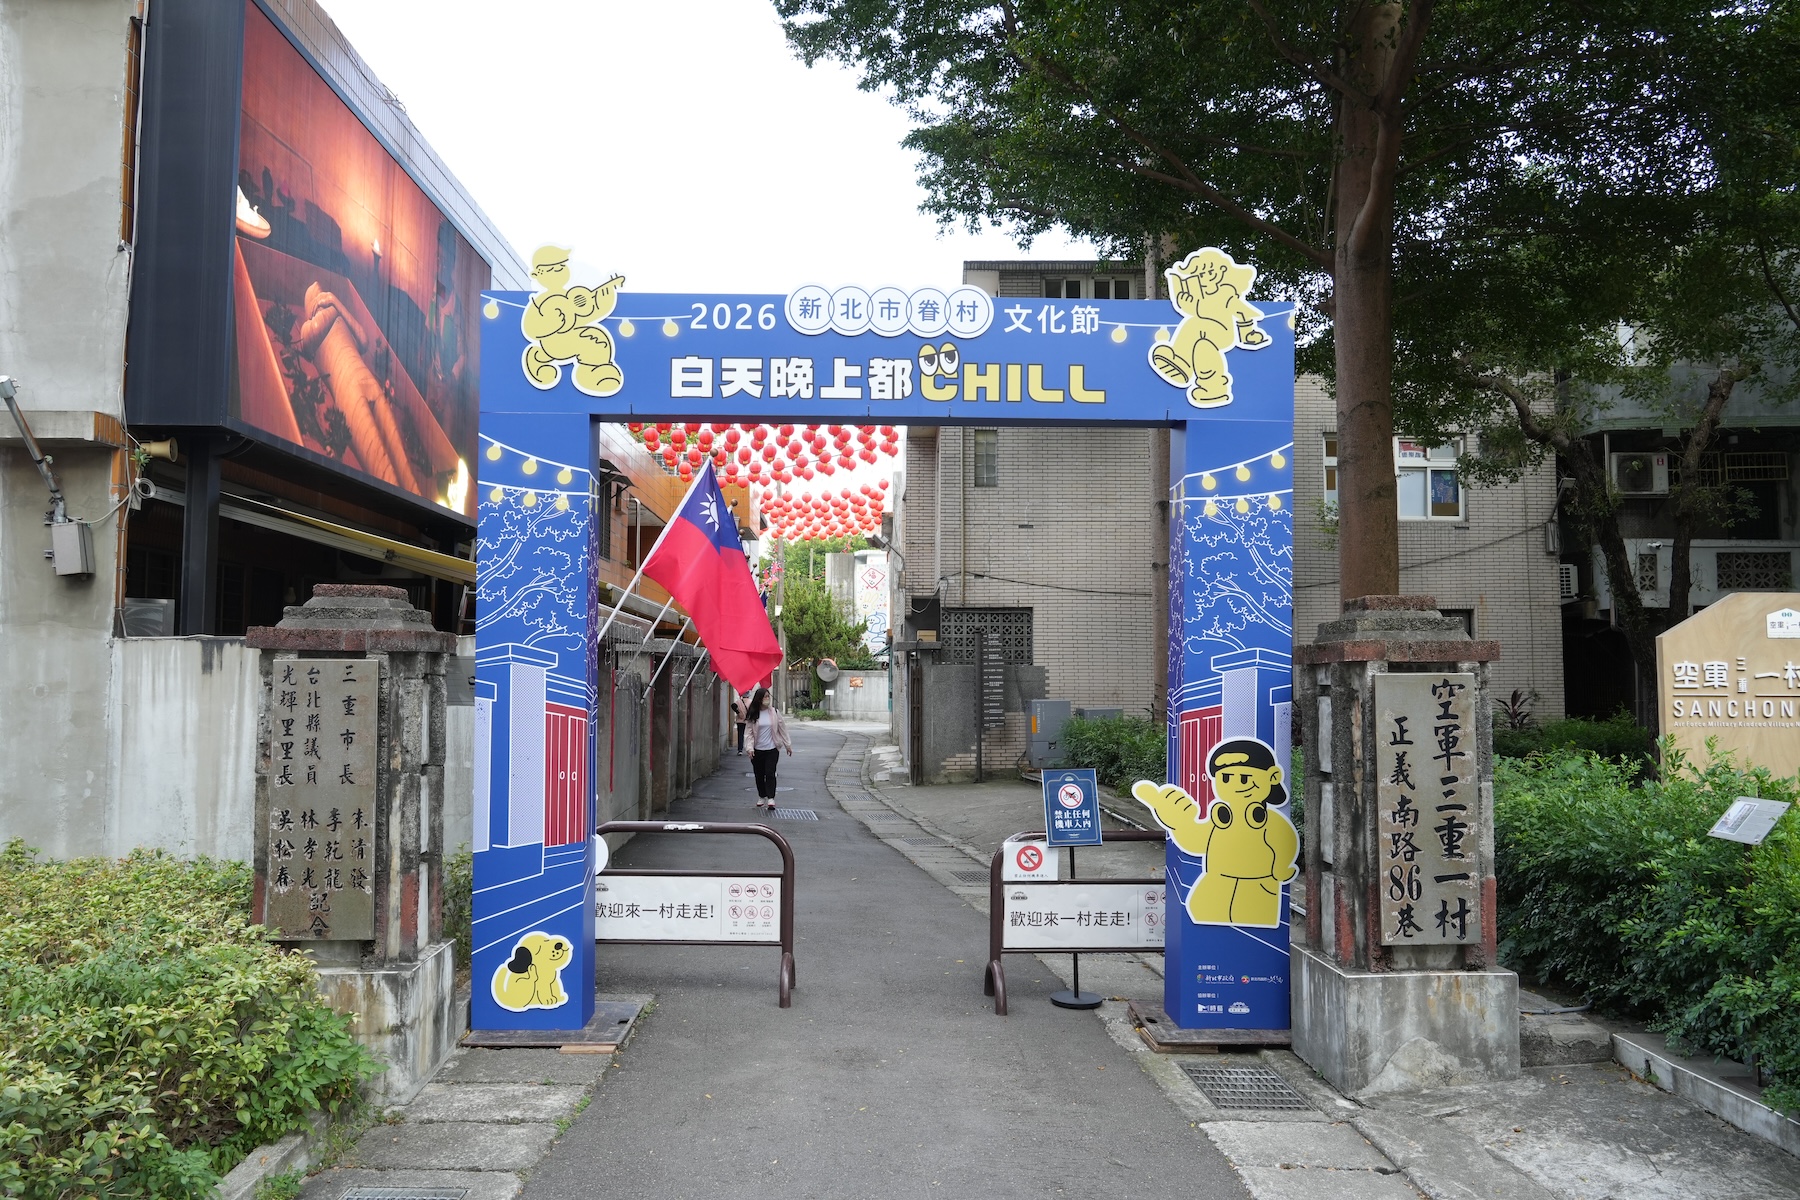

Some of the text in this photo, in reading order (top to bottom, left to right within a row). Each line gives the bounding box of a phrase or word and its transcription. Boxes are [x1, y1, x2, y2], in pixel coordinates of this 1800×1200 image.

[690, 296, 1100, 335] 2026 新北市眷村 文化節
[669, 355, 1106, 403] 白天晚上都 CHILL
[279, 664, 298, 785] 光輝里里長
[303, 665, 321, 785] 台北縣議員
[339, 664, 357, 785] 三重市長
[1768, 721, 1794, 729] Village
[1054, 809, 1090, 819] 禁止任何
[1389, 715, 1424, 938] 正義南路86巷
[1431, 678, 1471, 941] 空軍三重一村
[1010, 910, 1131, 928] 歡迎來一村走走!
